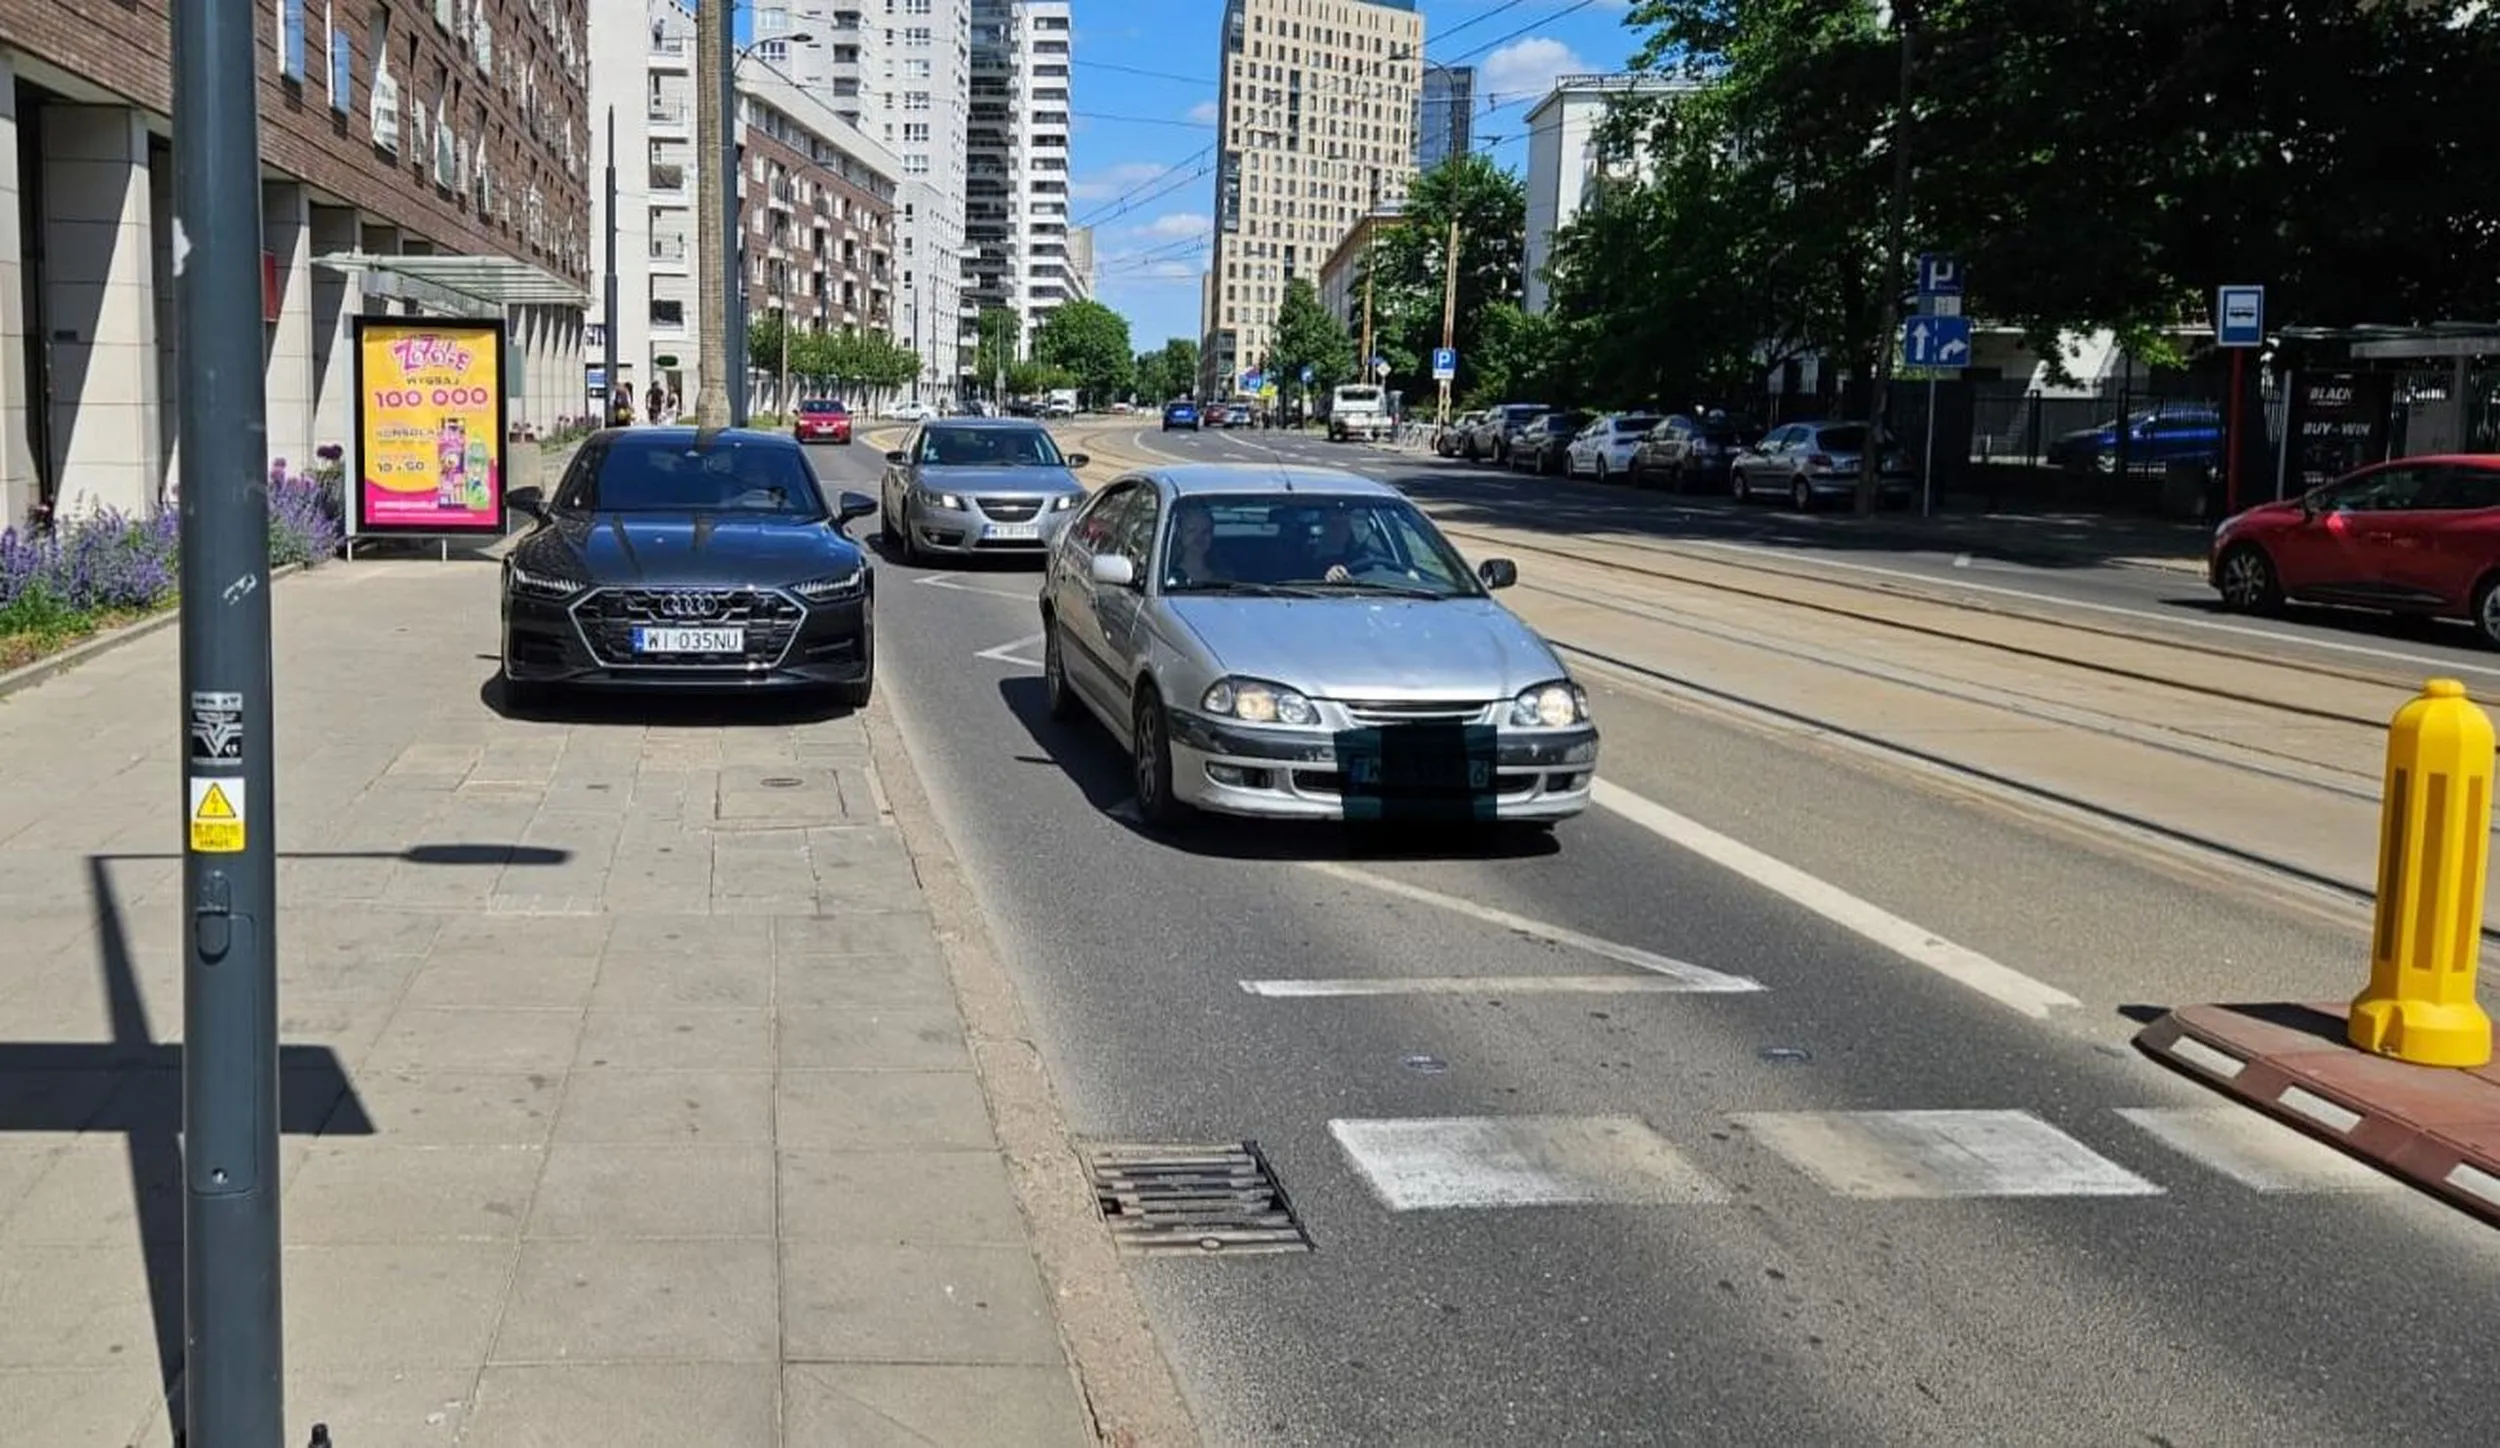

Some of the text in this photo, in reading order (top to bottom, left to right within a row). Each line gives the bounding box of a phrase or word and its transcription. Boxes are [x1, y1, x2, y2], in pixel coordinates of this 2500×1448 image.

[1438, 351, 1450, 367] P
[375, 387, 488, 408] 100 000
[648, 632, 738, 649] WI 035NU
